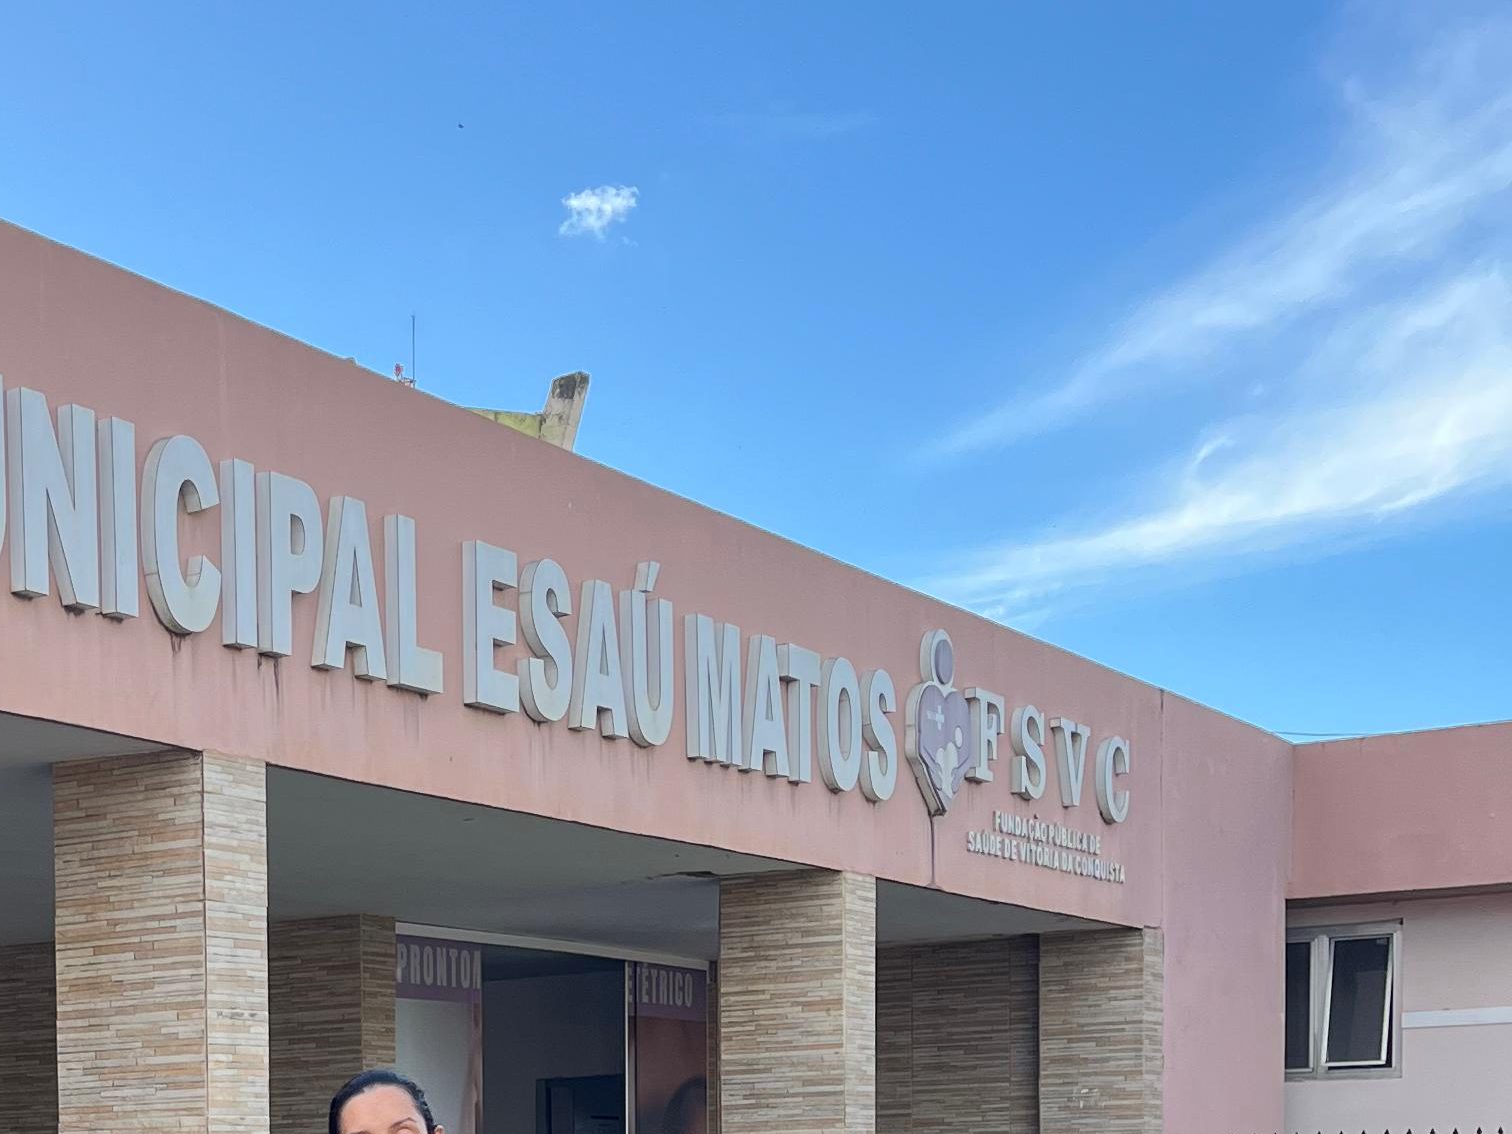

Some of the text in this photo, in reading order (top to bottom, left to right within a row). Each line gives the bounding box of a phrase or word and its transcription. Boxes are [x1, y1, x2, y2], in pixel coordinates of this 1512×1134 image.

[462, 539, 674, 748] ESAÚ
[685, 613, 897, 801] MATOS
[967, 829, 1126, 884] SAÚDE DE VITÓRIA DA CONQUISTA
[993, 811, 1101, 855] FUNDAÇÃO PÚBLICA DE
